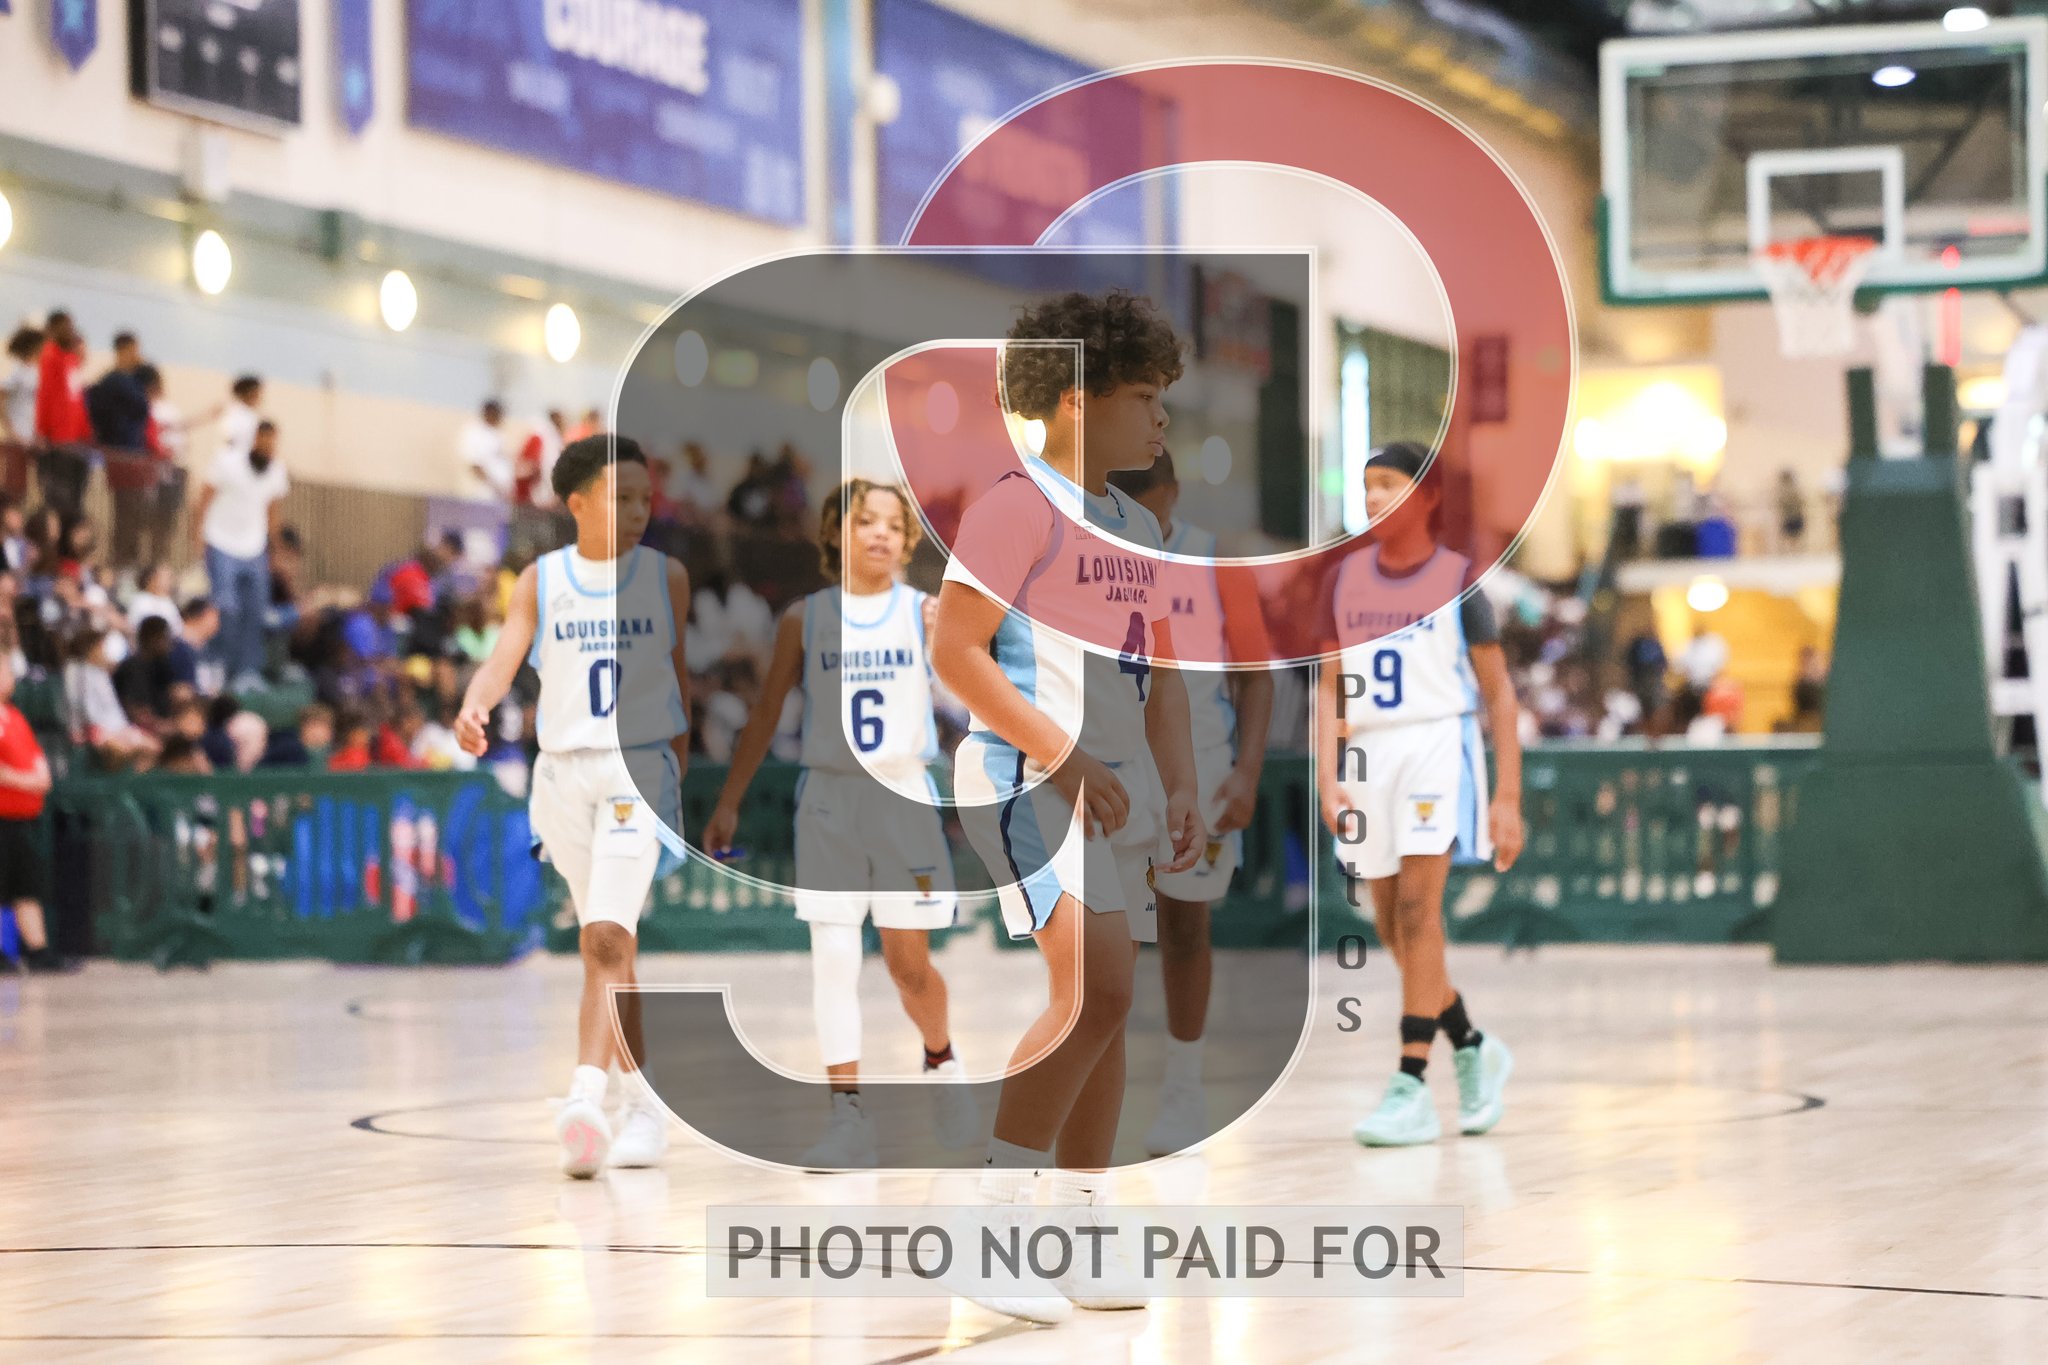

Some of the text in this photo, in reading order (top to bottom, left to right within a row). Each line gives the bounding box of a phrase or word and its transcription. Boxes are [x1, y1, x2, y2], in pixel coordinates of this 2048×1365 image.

[1076, 554, 1157, 588] LOUISIAN
[555, 617, 654, 640] LOUISIANA
[1118, 611, 1150, 701] 4
[589, 658, 622, 717] 0
[1373, 649, 1402, 708] 9
[851, 689, 884, 752] 6
